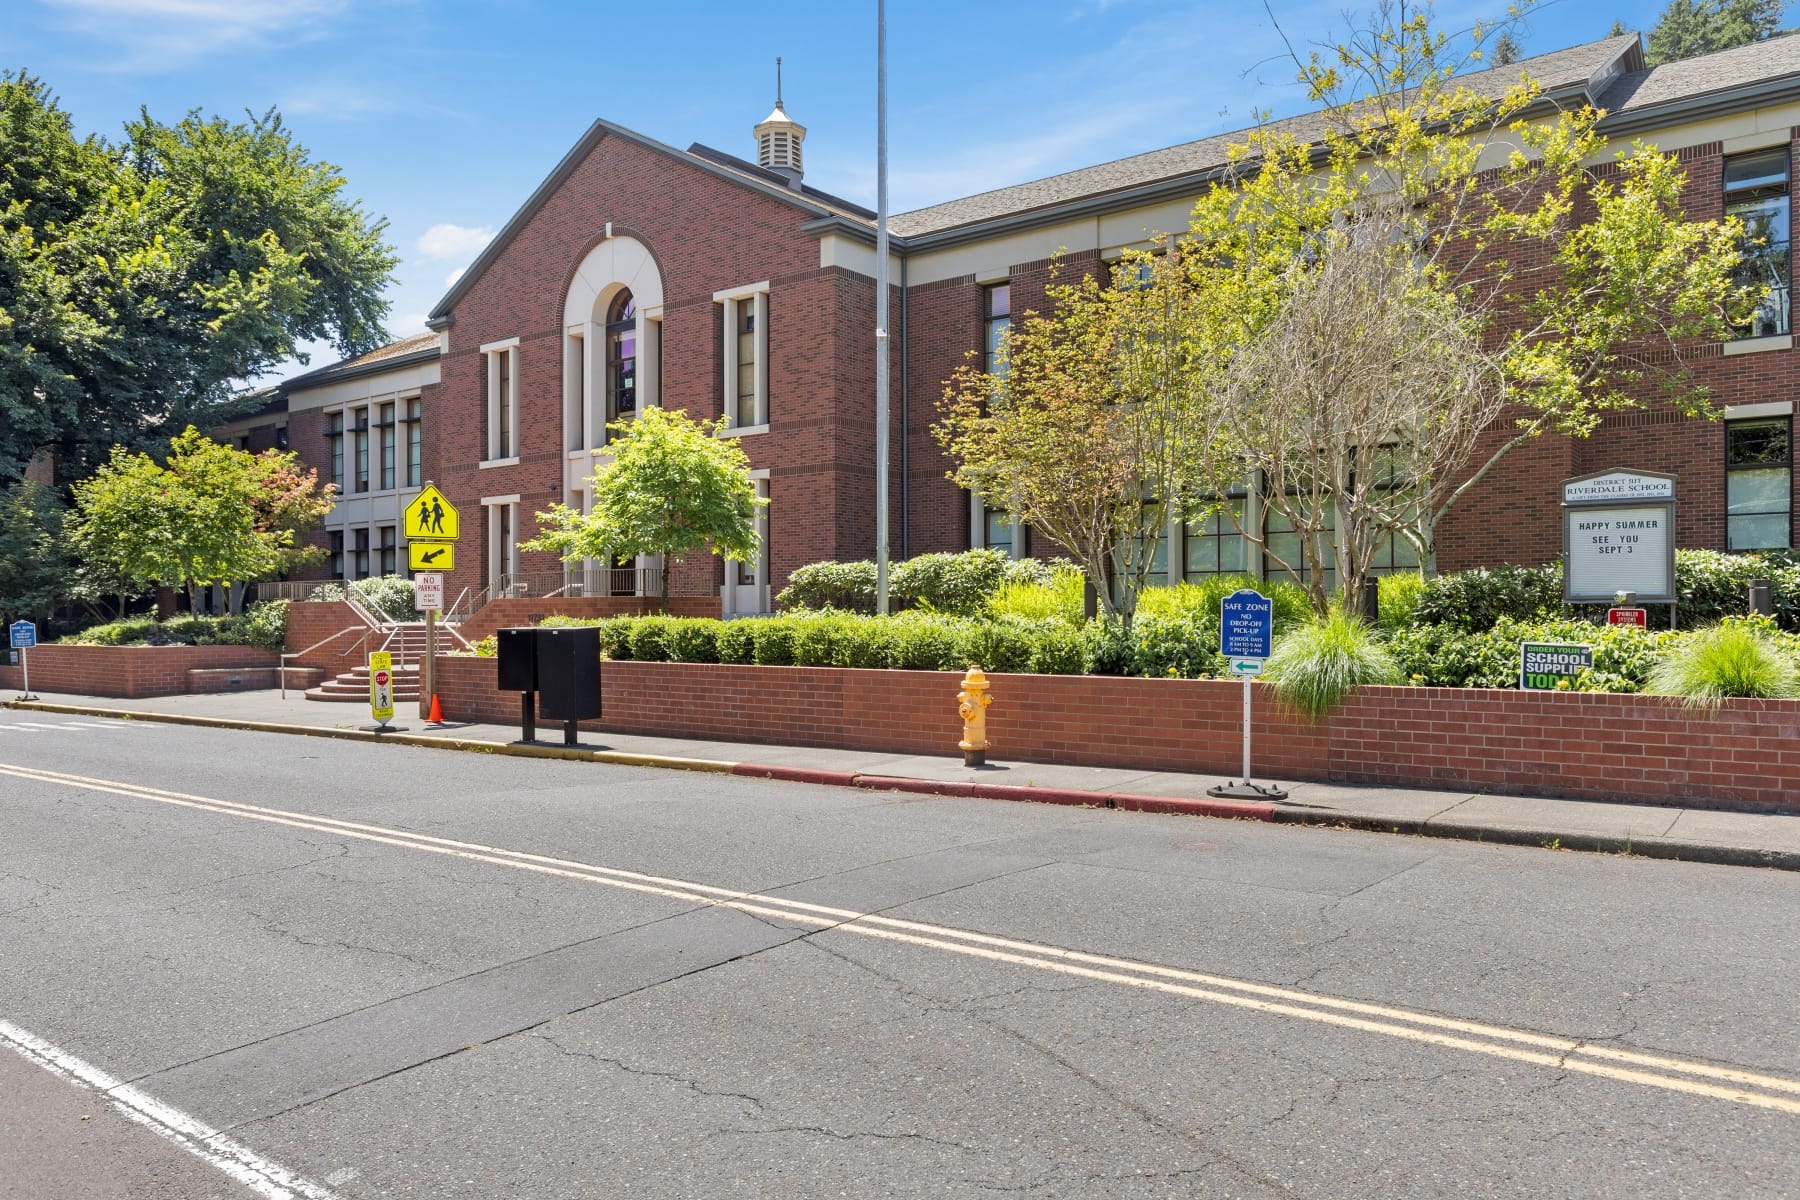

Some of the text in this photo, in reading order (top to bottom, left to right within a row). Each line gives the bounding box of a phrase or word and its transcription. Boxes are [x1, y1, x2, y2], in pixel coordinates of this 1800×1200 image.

[1593, 478, 1625, 486] DISTRICT
[1567, 483, 1670, 494] RIVERDALE SCHOOL
[1579, 520, 1658, 531] HAPPY SUMMER
[1592, 535, 1639, 544] SEE YOU
[1598, 545, 1633, 554] SEPT 3
[423, 576, 435, 585] NO
[417, 584, 441, 592] PARKING
[1526, 652, 1590, 665] SCHOOL
[1526, 662, 1588, 675] SUPPLIE
